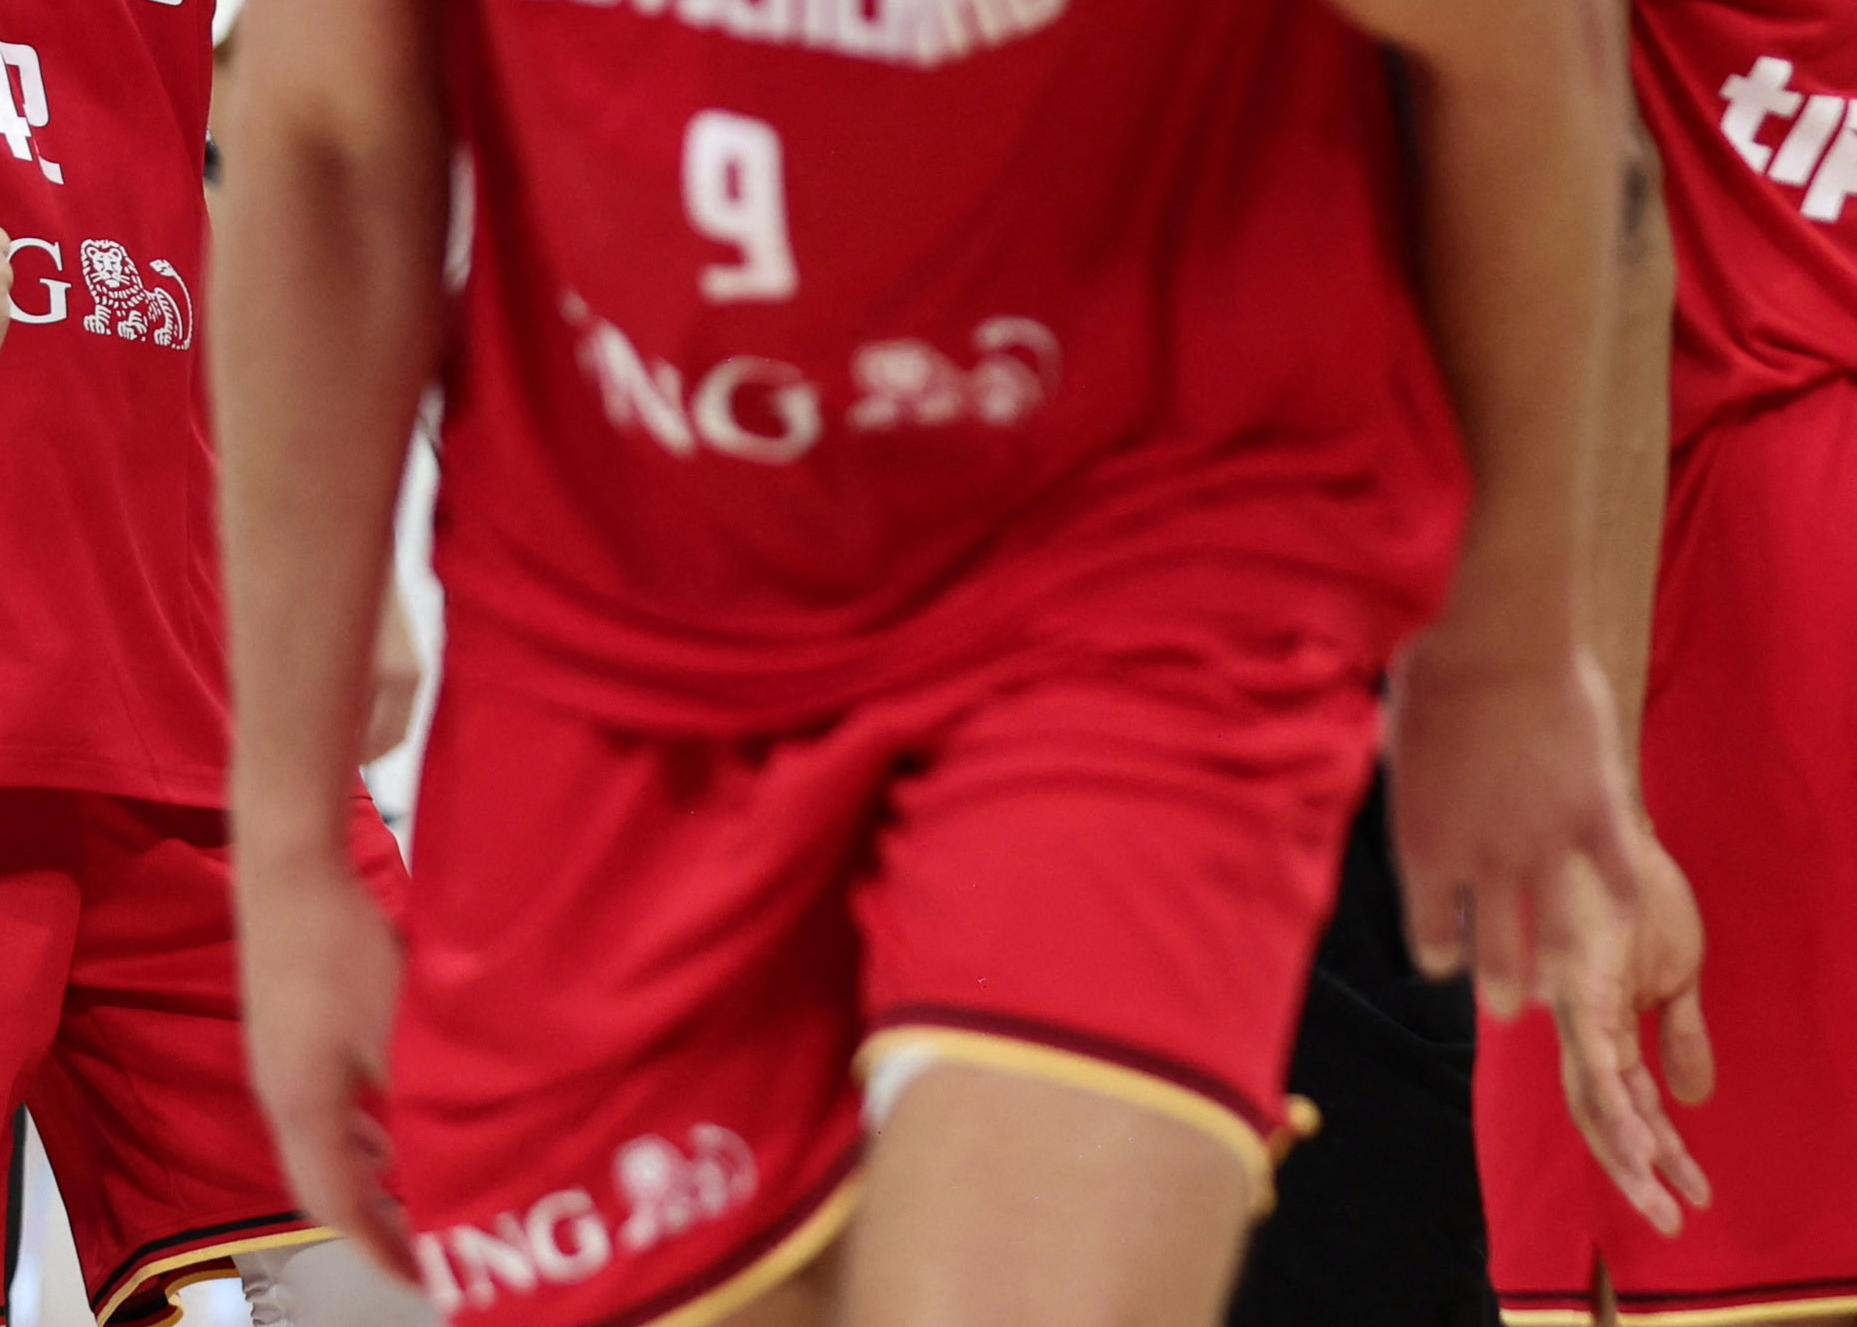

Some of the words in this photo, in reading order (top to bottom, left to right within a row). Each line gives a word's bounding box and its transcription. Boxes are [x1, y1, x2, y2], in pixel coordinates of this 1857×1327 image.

[683, 107, 799, 305] 9
[558, 285, 823, 463] NG
[415, 1185, 611, 1315] ING
